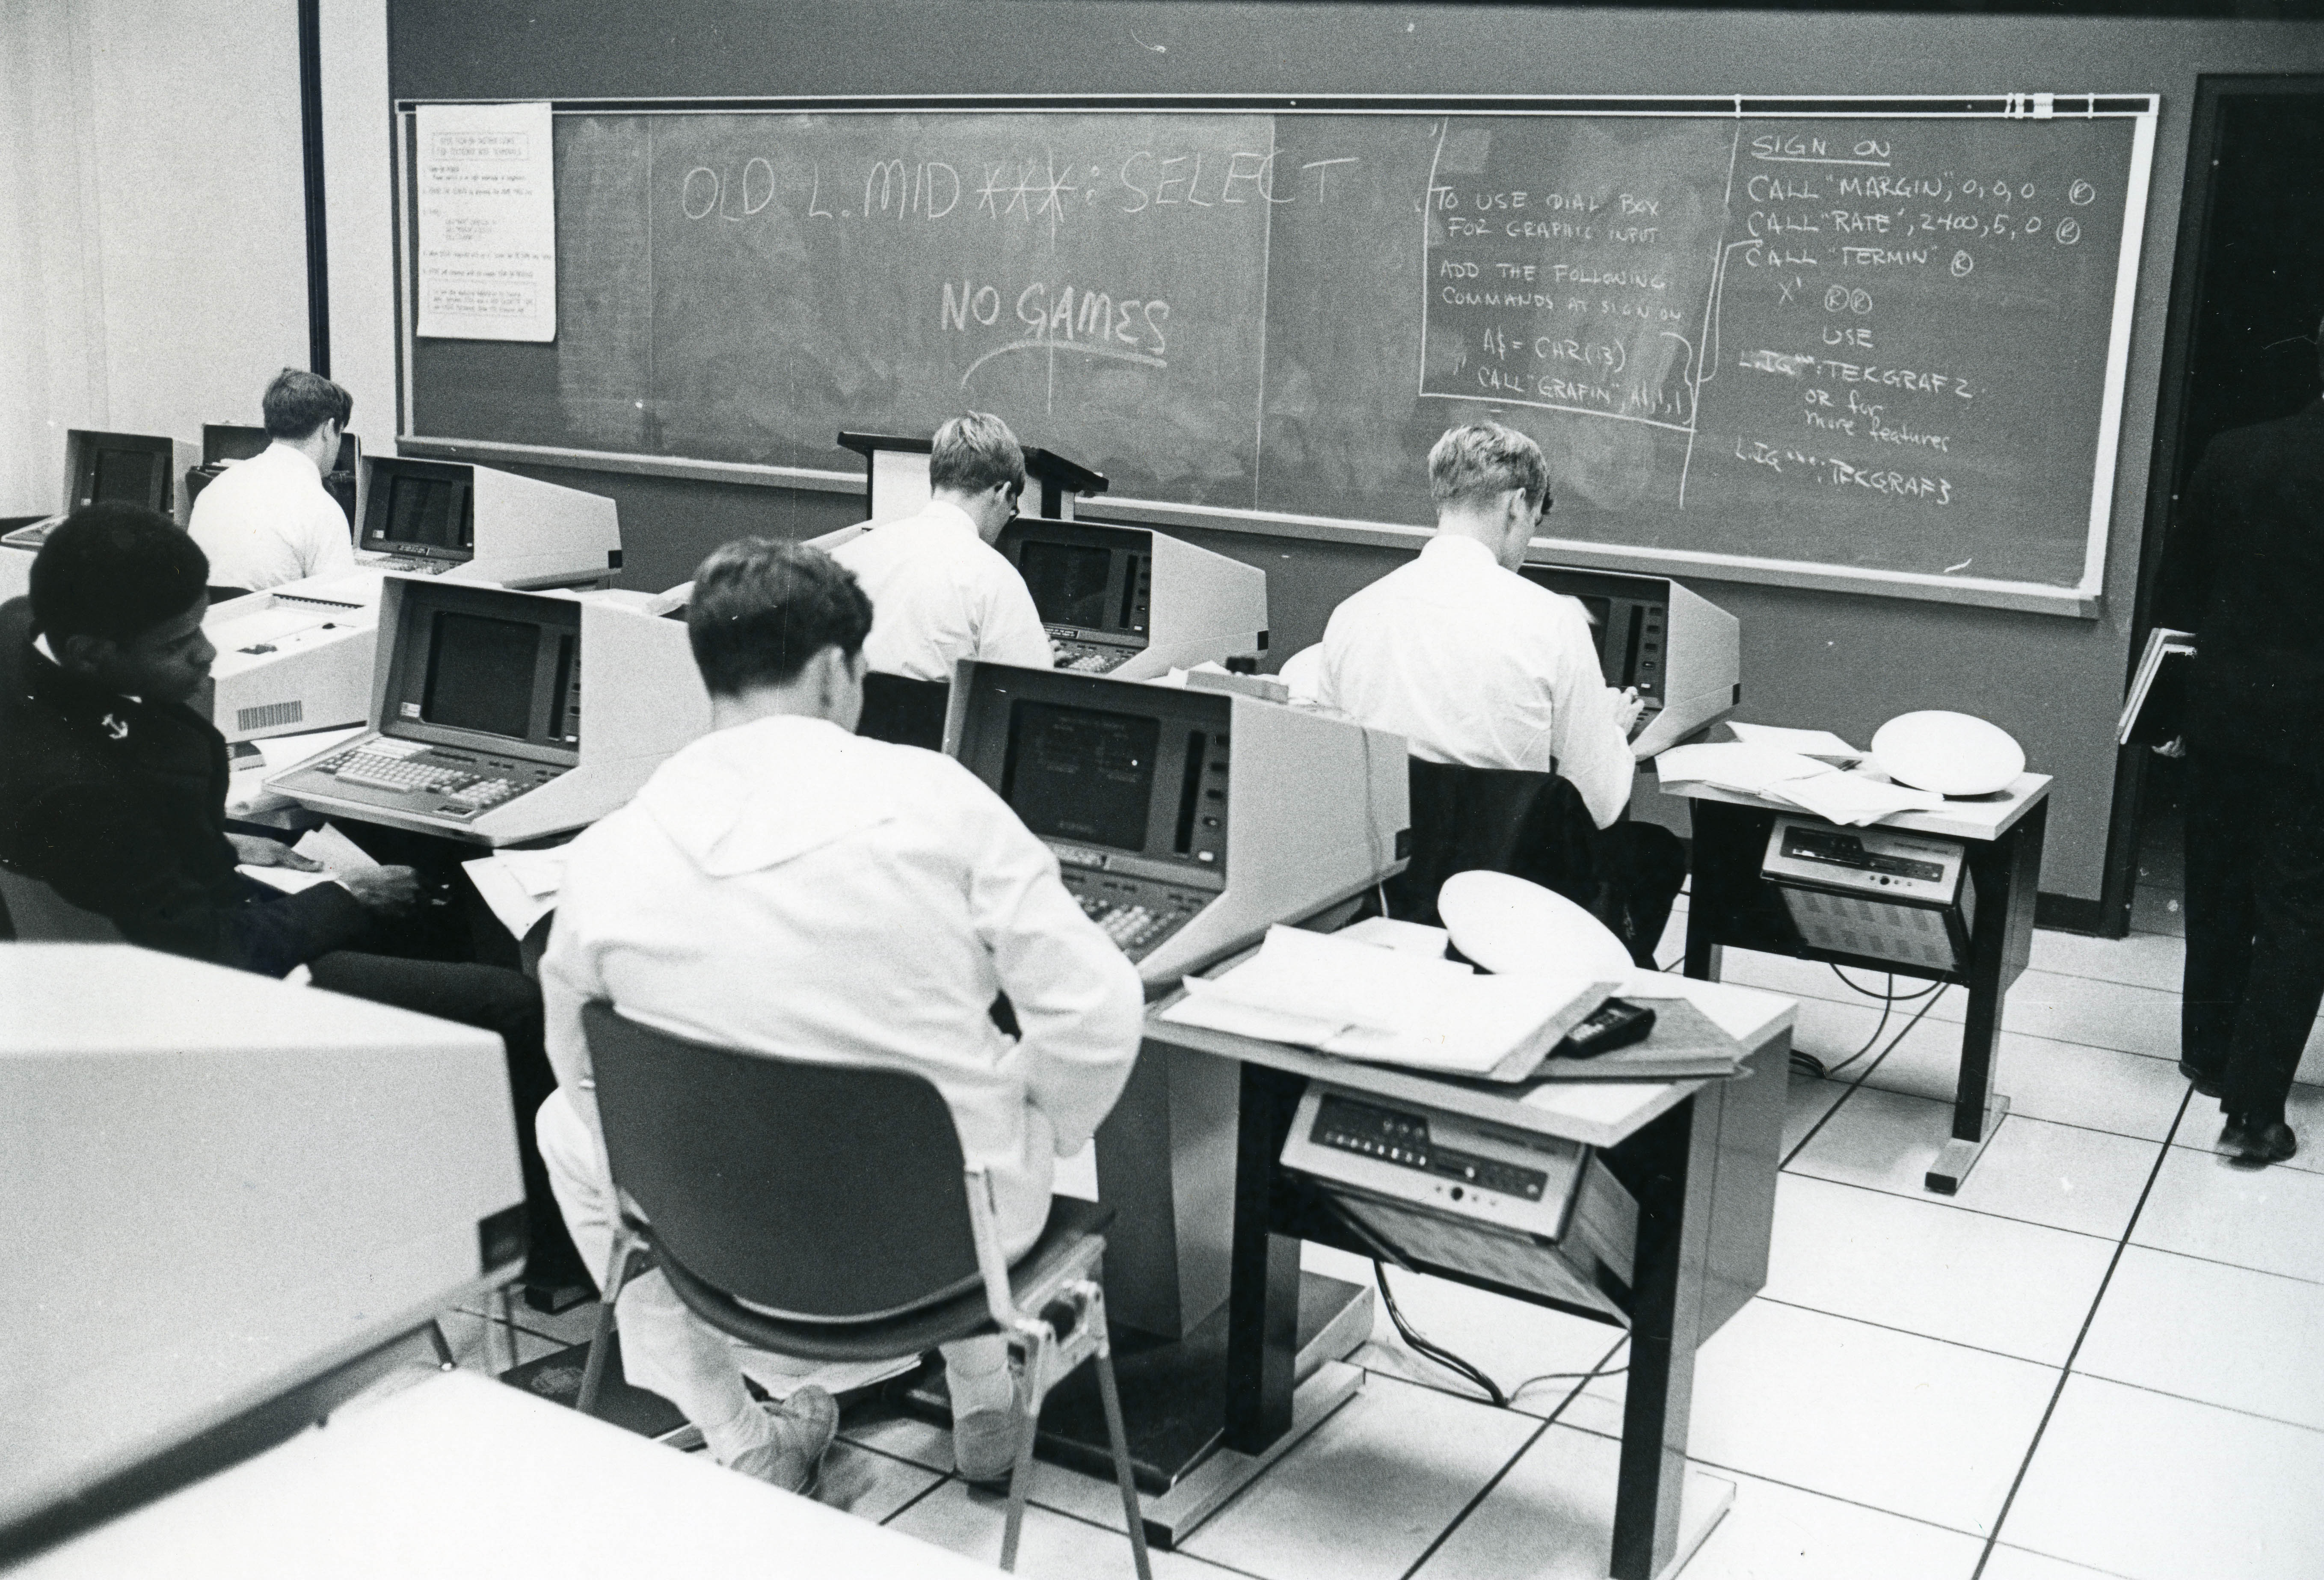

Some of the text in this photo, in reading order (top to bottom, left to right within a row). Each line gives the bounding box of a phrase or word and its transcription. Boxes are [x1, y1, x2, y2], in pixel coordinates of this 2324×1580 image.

[1751, 135, 1890, 157] SIGN ON
[682, 157, 774, 221] OLD
[1121, 151, 1360, 213] SELECT
[1748, 174, 1819, 202] CALL
[1431, 186, 1660, 216] TO USE DIAL BOX
[1448, 217, 1658, 243] FOR GRAPHIC INPUT
[1748, 211, 1819, 237] CALL
[1745, 247, 1817, 267] CALL
[1440, 260, 1666, 290] ADD THE FOLLOWING
[1442, 286, 1681, 320] COMMANDS AT SIGN ON
[941, 280, 1170, 355] NO GAMES
[1823, 326, 1874, 348] USE
[1478, 365, 1525, 392] CALL
[1805, 389, 1834, 407] OR
[1805, 409, 1855, 436] more
